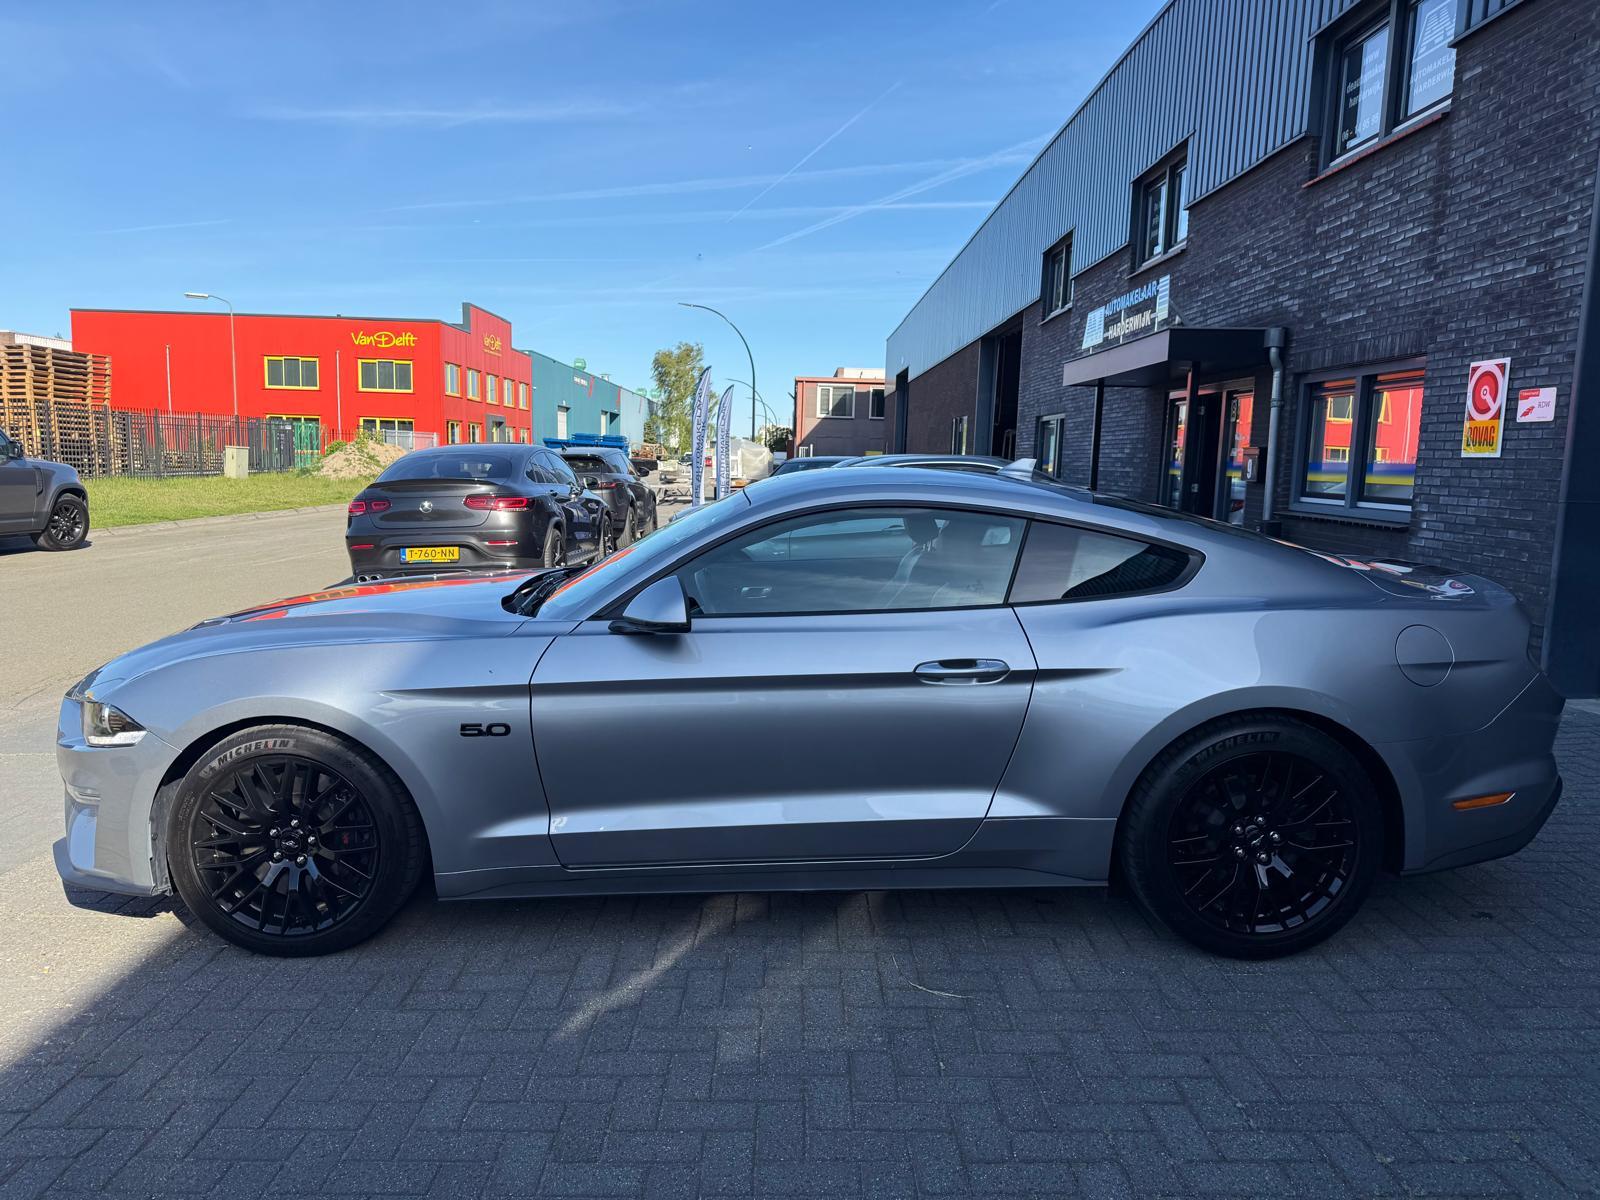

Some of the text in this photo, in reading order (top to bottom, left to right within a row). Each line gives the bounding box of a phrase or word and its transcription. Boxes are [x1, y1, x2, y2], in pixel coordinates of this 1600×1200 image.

[1411, 50, 1456, 84] AUTOMAKELA
[1413, 65, 1455, 97] HARDERWIJ
[1105, 280, 1157, 317] AUTOMAKELAAR
[1108, 310, 1152, 340] HARDERWIJK
[1246, 459, 1253, 479] 9
[409, 549, 455, 559] T-760-NN
[217, 740, 290, 767] MICHELIN
[1195, 732, 1276, 764] MICHELIN
